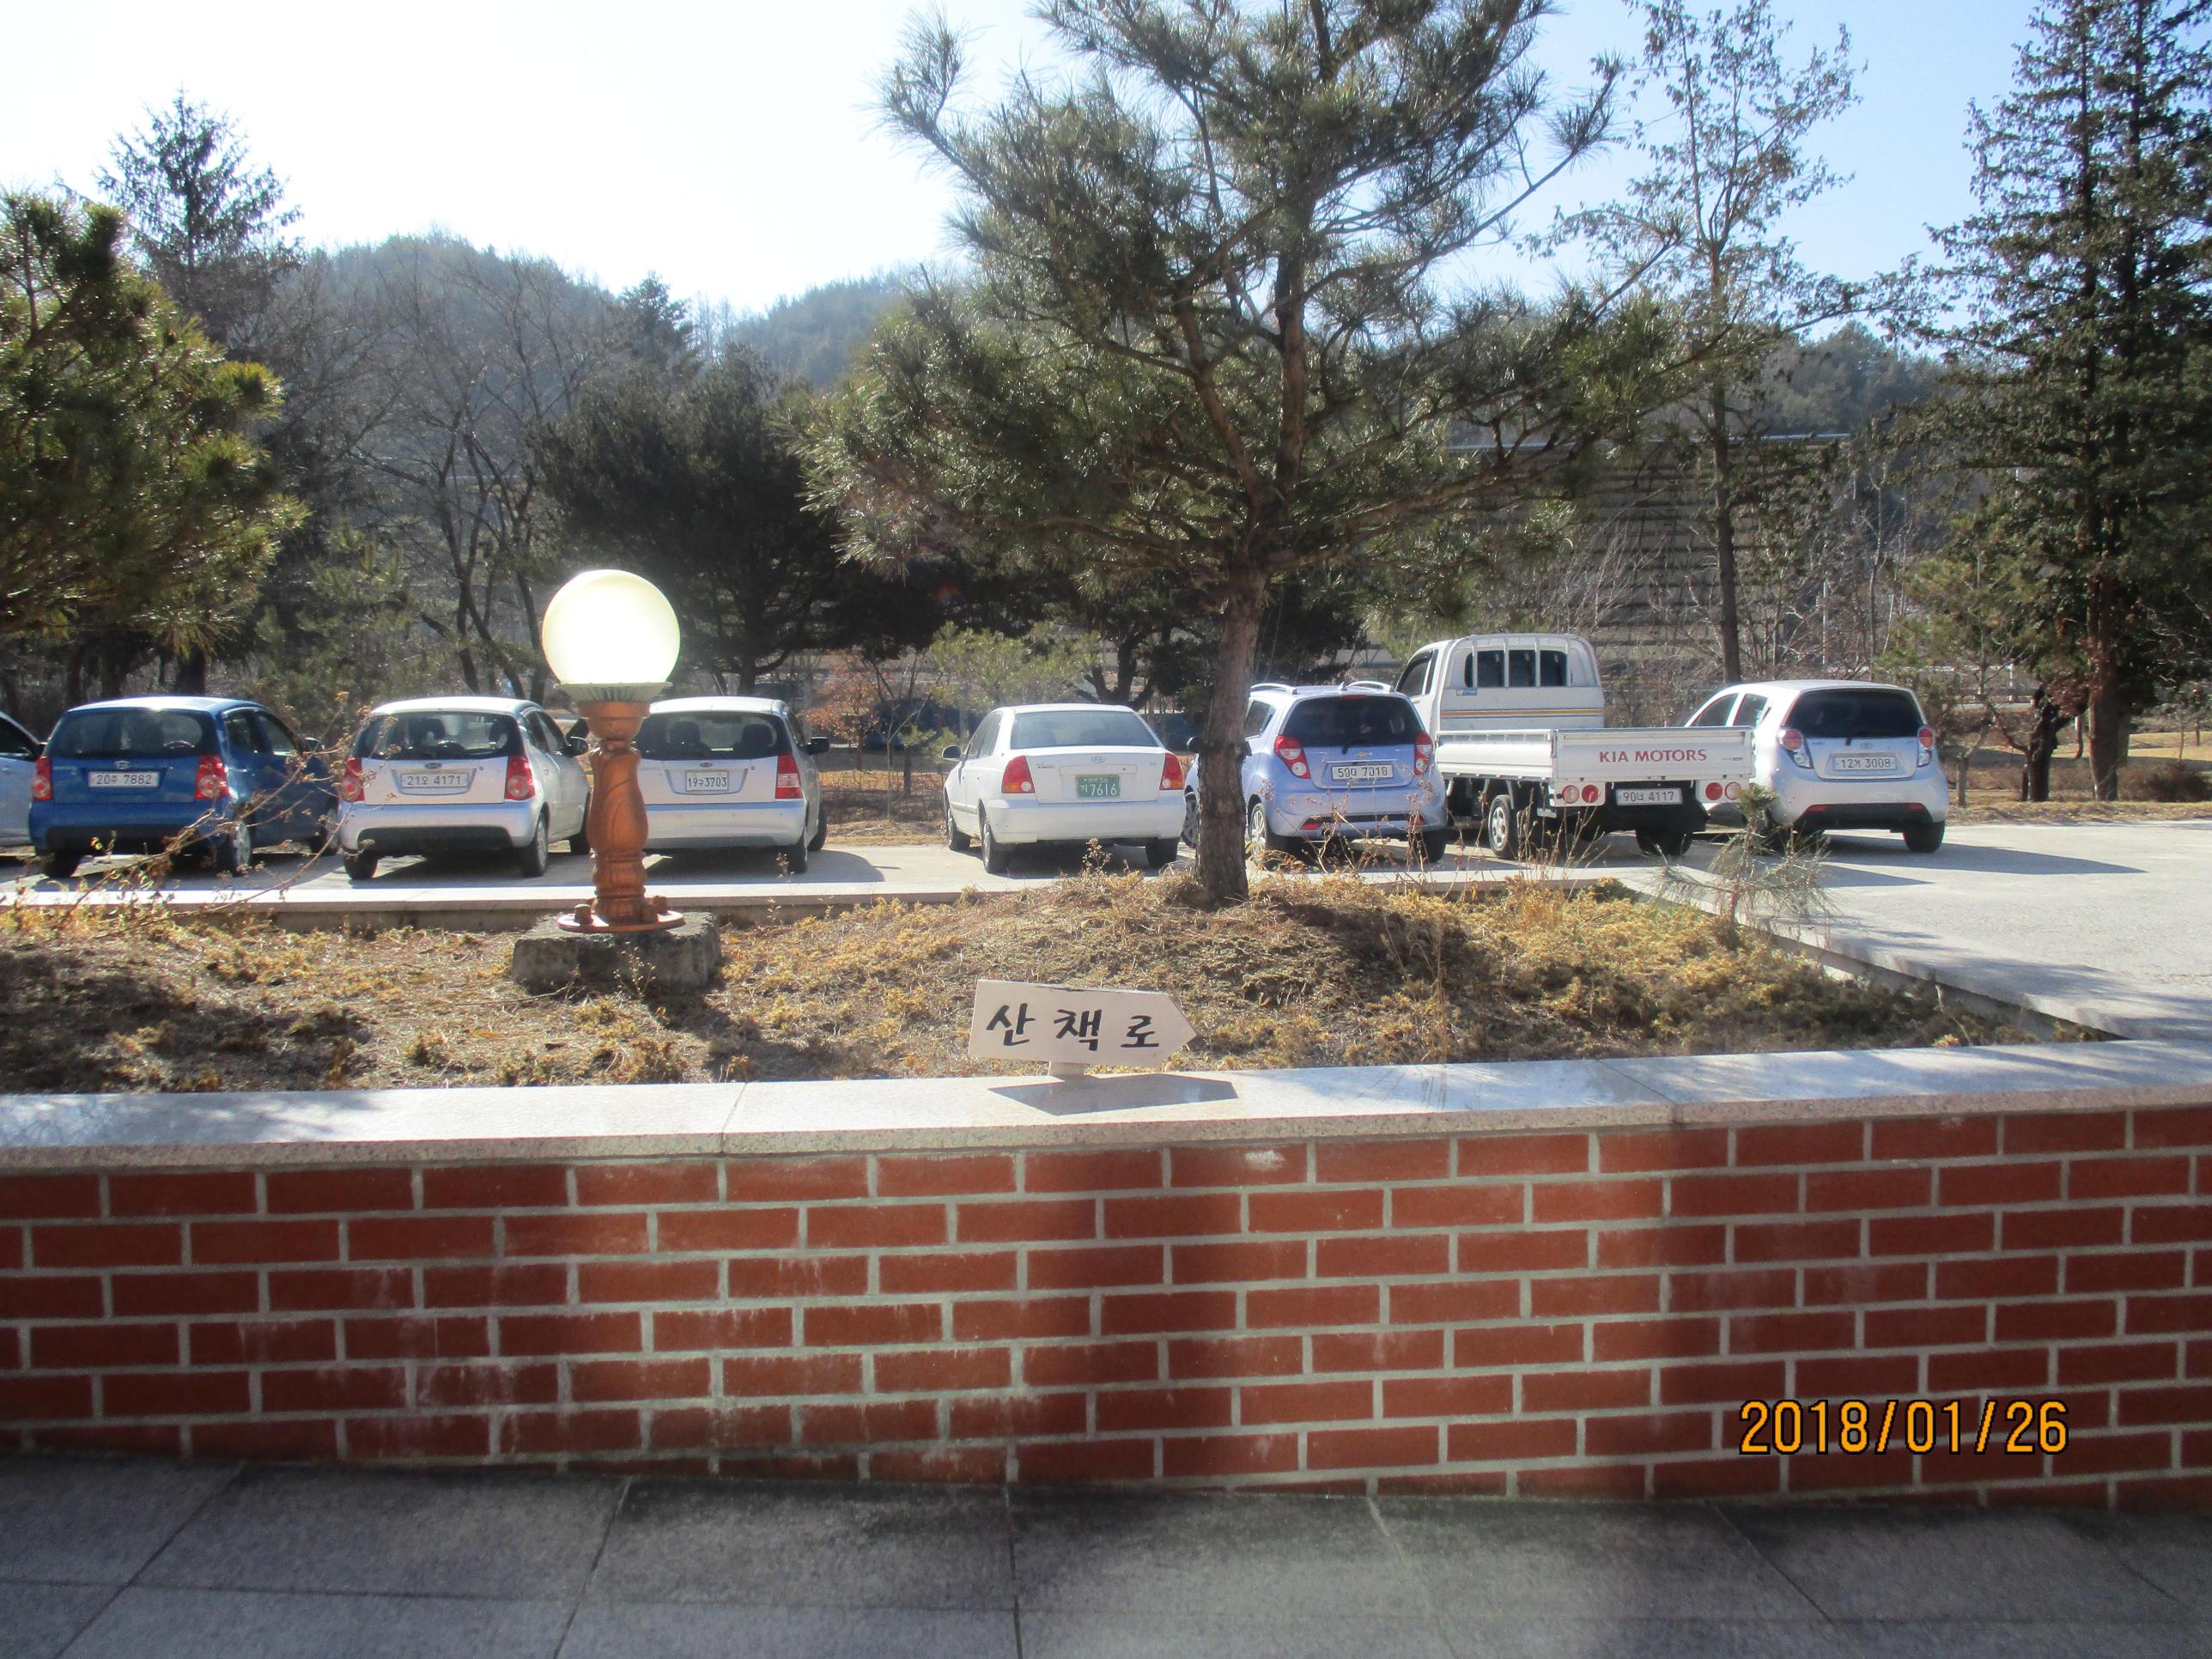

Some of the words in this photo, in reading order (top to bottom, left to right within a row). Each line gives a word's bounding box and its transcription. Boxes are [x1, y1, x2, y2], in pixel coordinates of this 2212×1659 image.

[1599, 750, 1629, 763] KIA
[1634, 749, 1708, 762] MOTORS
[986, 1002, 1159, 1052] 산책로
